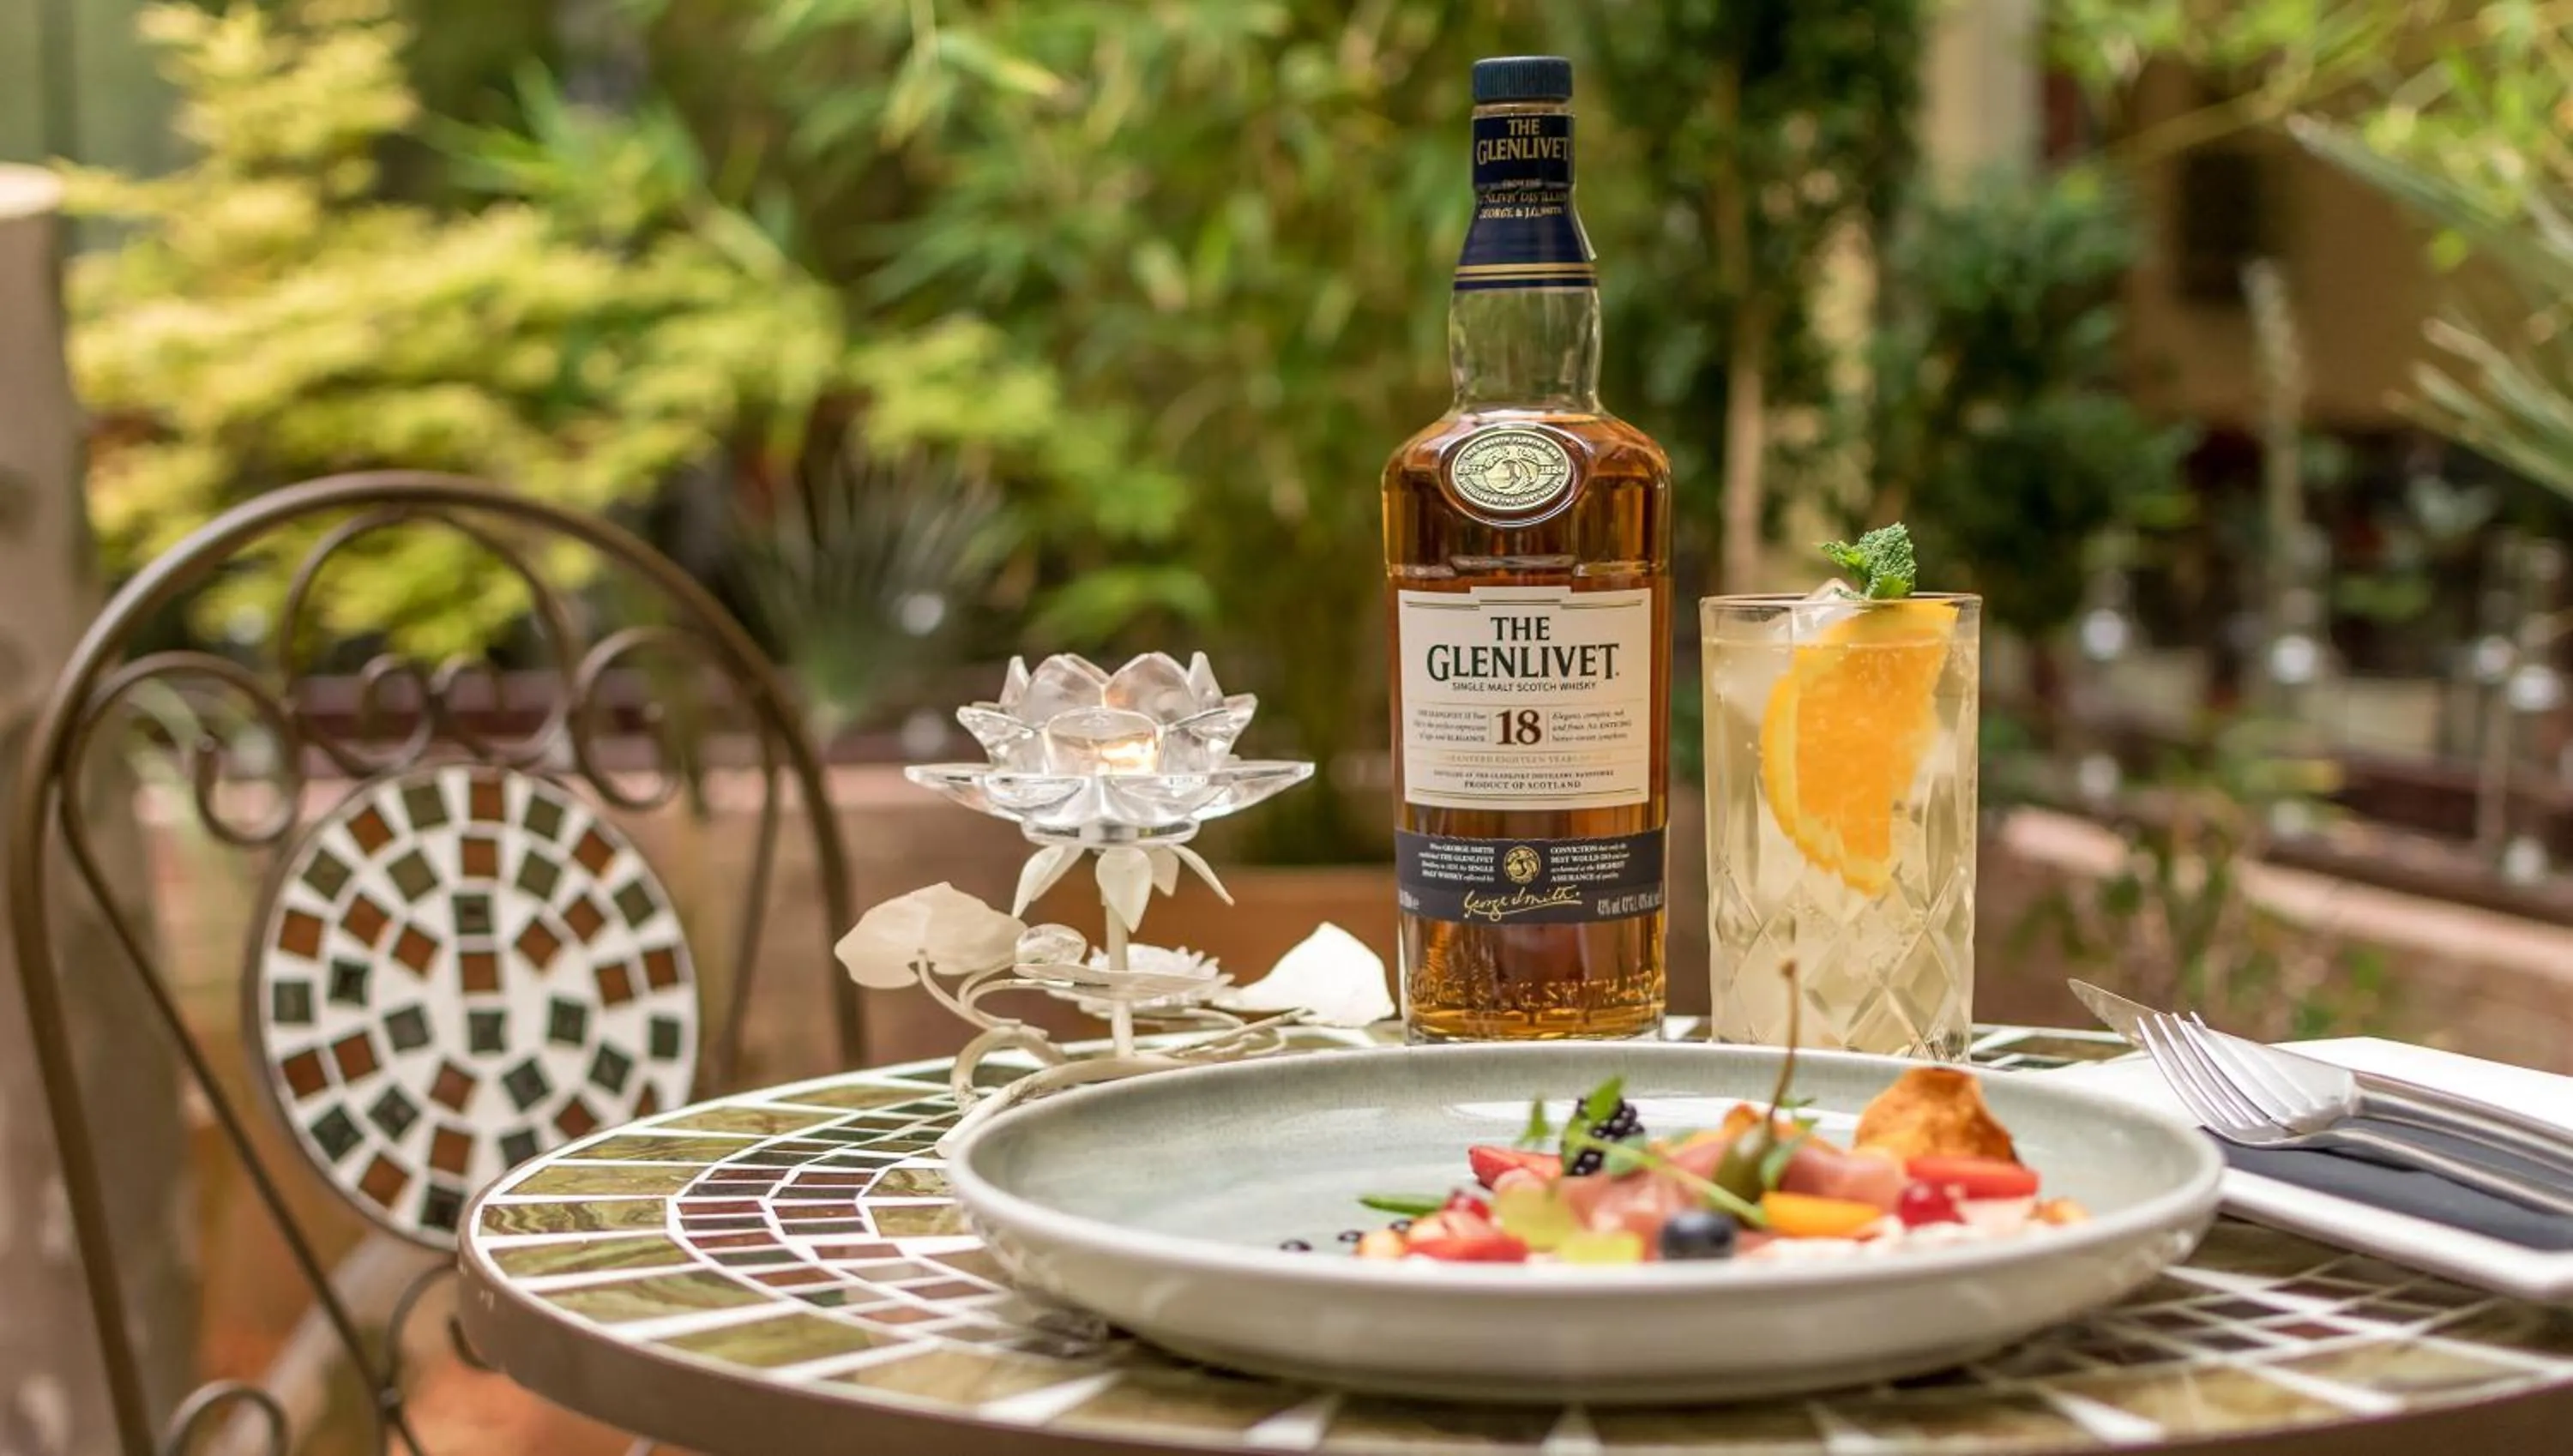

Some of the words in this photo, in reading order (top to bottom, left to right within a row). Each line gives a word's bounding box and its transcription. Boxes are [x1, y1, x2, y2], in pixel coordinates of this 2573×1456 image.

[1507, 118, 1541, 135] THE
[1477, 137, 1569, 165] GLENLIVET
[1490, 617, 1550, 641] THE
[1426, 643, 1619, 682] GLENLIVET
[1452, 683, 1485, 691] SINGLE
[1488, 683, 1514, 691] MALT
[1517, 682, 1557, 692] SCOTCH
[1560, 681, 1596, 691] WHISKY
[1496, 709, 1541, 745] 18
[1464, 781, 1509, 790] PRODUCT
[1512, 781, 1524, 790] OF
[1527, 781, 1582, 790] SCOTLAND
[1464, 889, 1509, 922] George
